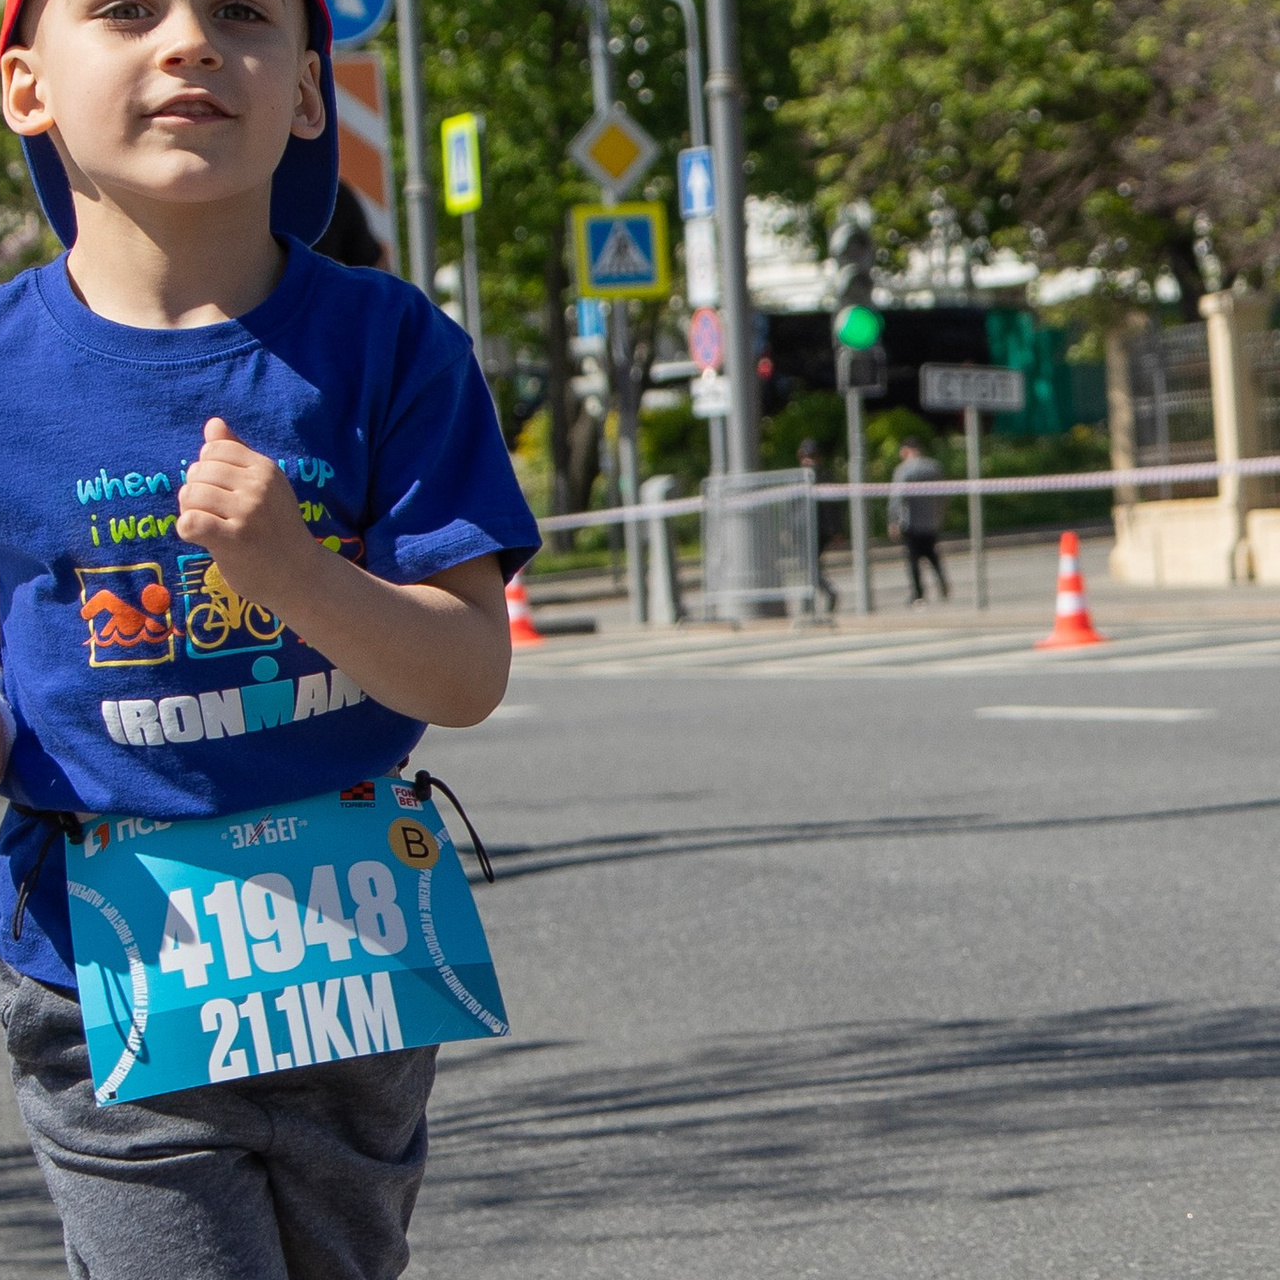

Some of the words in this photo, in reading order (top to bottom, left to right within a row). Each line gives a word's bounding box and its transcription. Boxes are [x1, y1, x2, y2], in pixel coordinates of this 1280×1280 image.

[76, 468, 172, 505] when
[91, 514, 100, 547] i
[109, 514, 177, 544] wan
[101, 656, 363, 746] IRONMAN
[340, 801, 376, 809] TORERO
[399, 797, 418, 807] BET
[98, 900, 135, 946] #ВОСТОРГ
[159, 860, 408, 989] 41948
[419, 911, 446, 968] #ГОРДОСТЬ
[436, 962, 484, 1016] #ЕДИНСТВО
